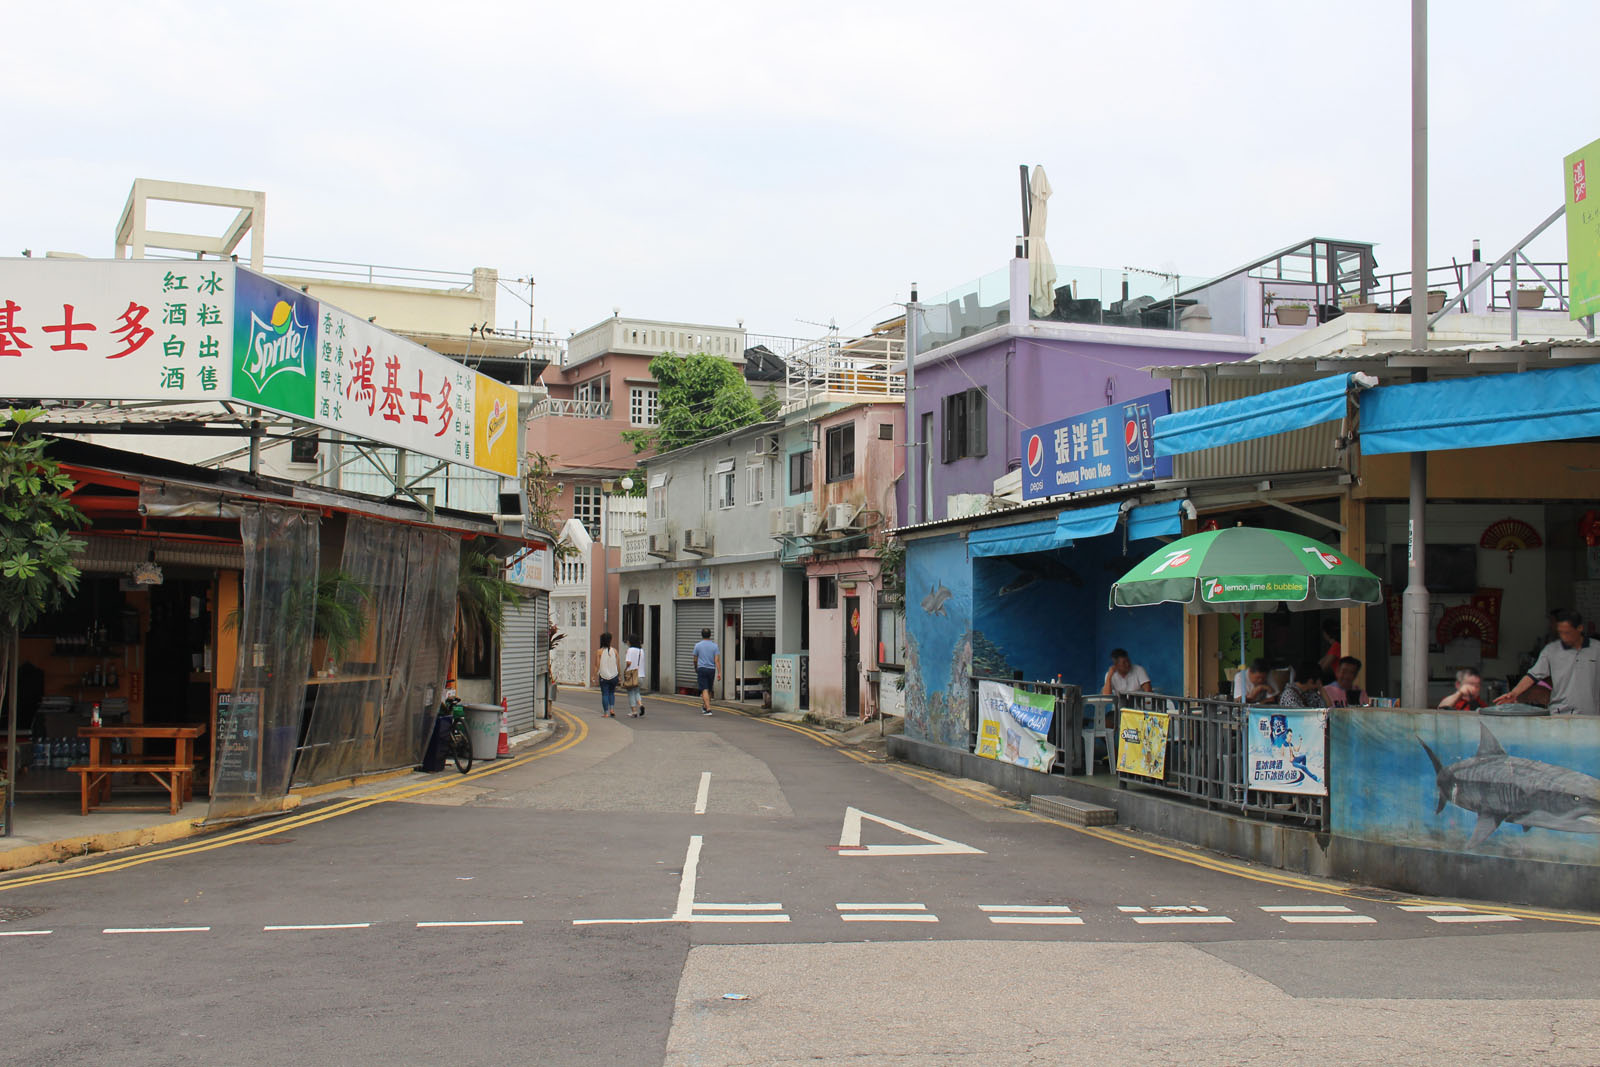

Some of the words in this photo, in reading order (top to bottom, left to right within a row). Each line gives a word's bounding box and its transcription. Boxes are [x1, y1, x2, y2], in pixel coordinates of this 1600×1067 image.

[160, 271, 189, 391] 紅酒白酒
[196, 271, 225, 391] 冰粒出售
[250, 321, 301, 380] Sprite
[346, 344, 454, 438] 鴻基士多
[1029, 480, 1044, 494] pepsi
[1056, 469, 1079, 486] Cheung
[1080, 466, 1097, 481] Poon
[1098, 462, 1111, 478] Kee
[1273, 583, 1303, 591] bubbles
